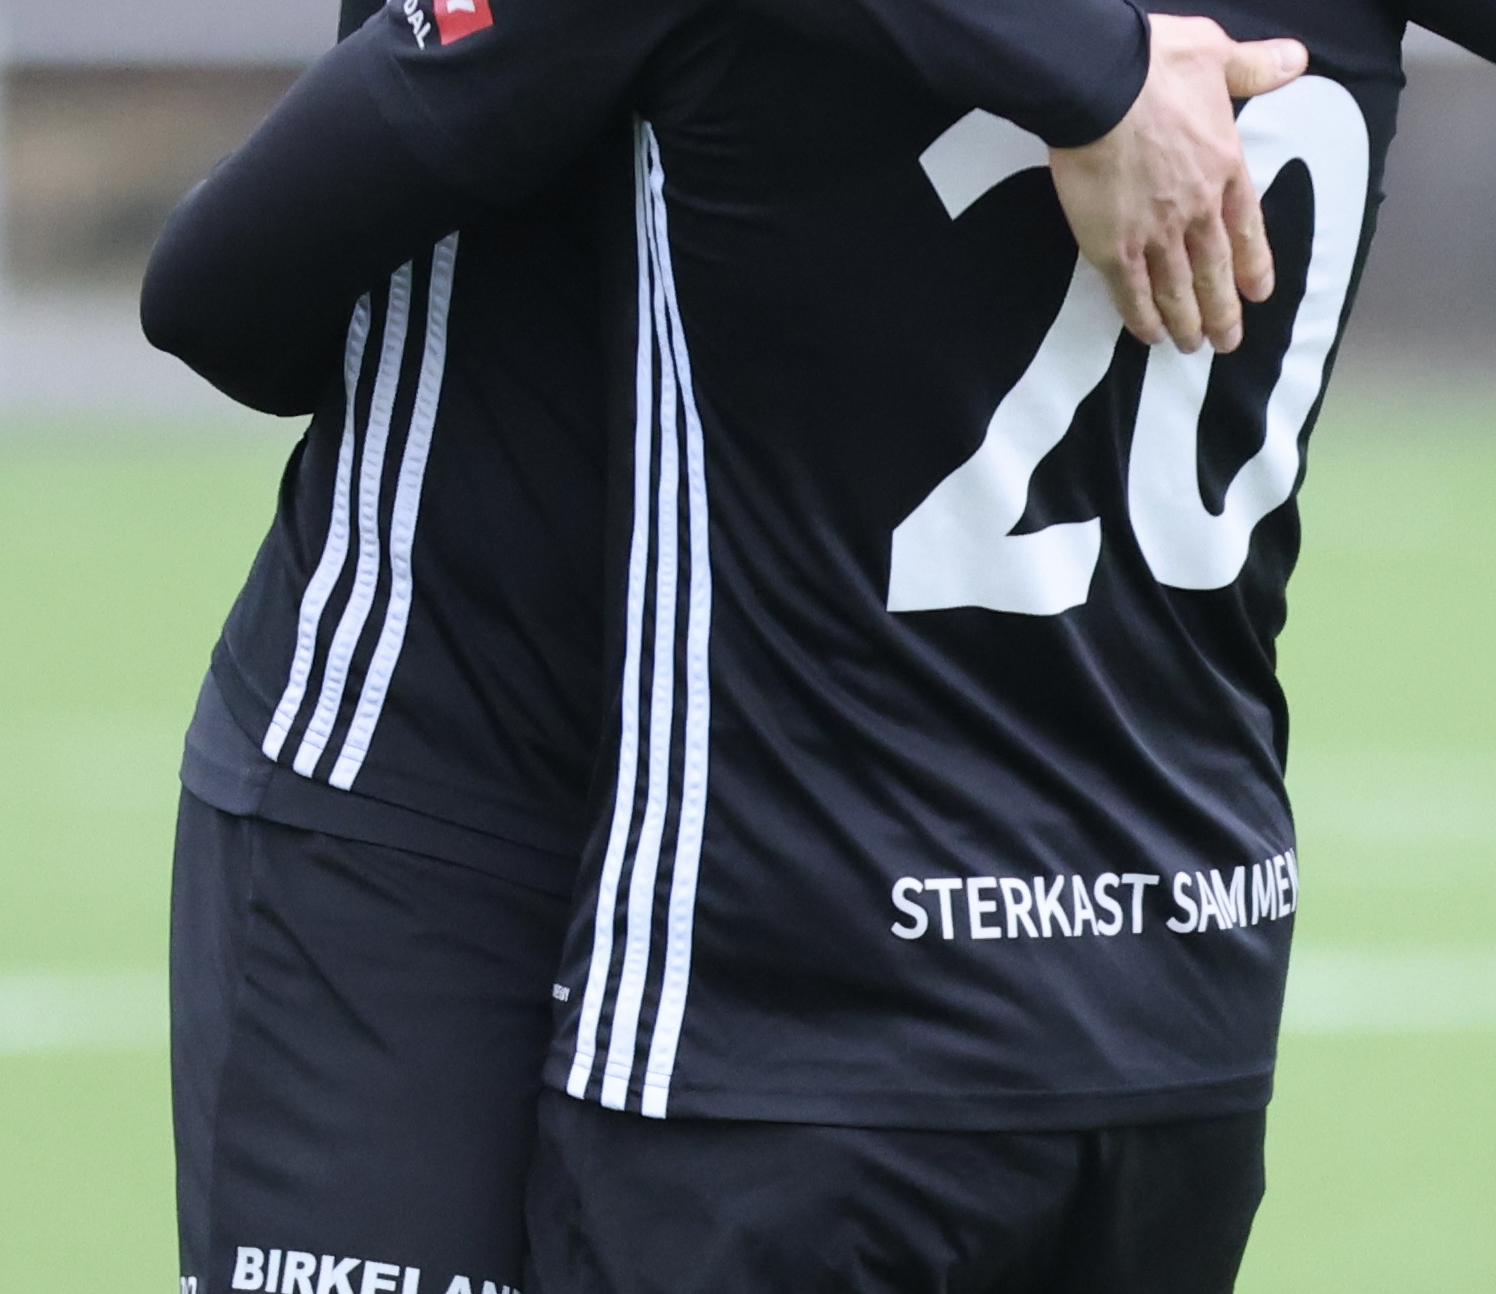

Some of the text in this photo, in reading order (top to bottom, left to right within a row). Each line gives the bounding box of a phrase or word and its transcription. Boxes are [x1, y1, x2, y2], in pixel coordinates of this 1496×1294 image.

[886, 74, 1370, 616] 20
[890, 872, 1160, 940] STERKAST
[231, 1246, 522, 1294] BIRKEL
